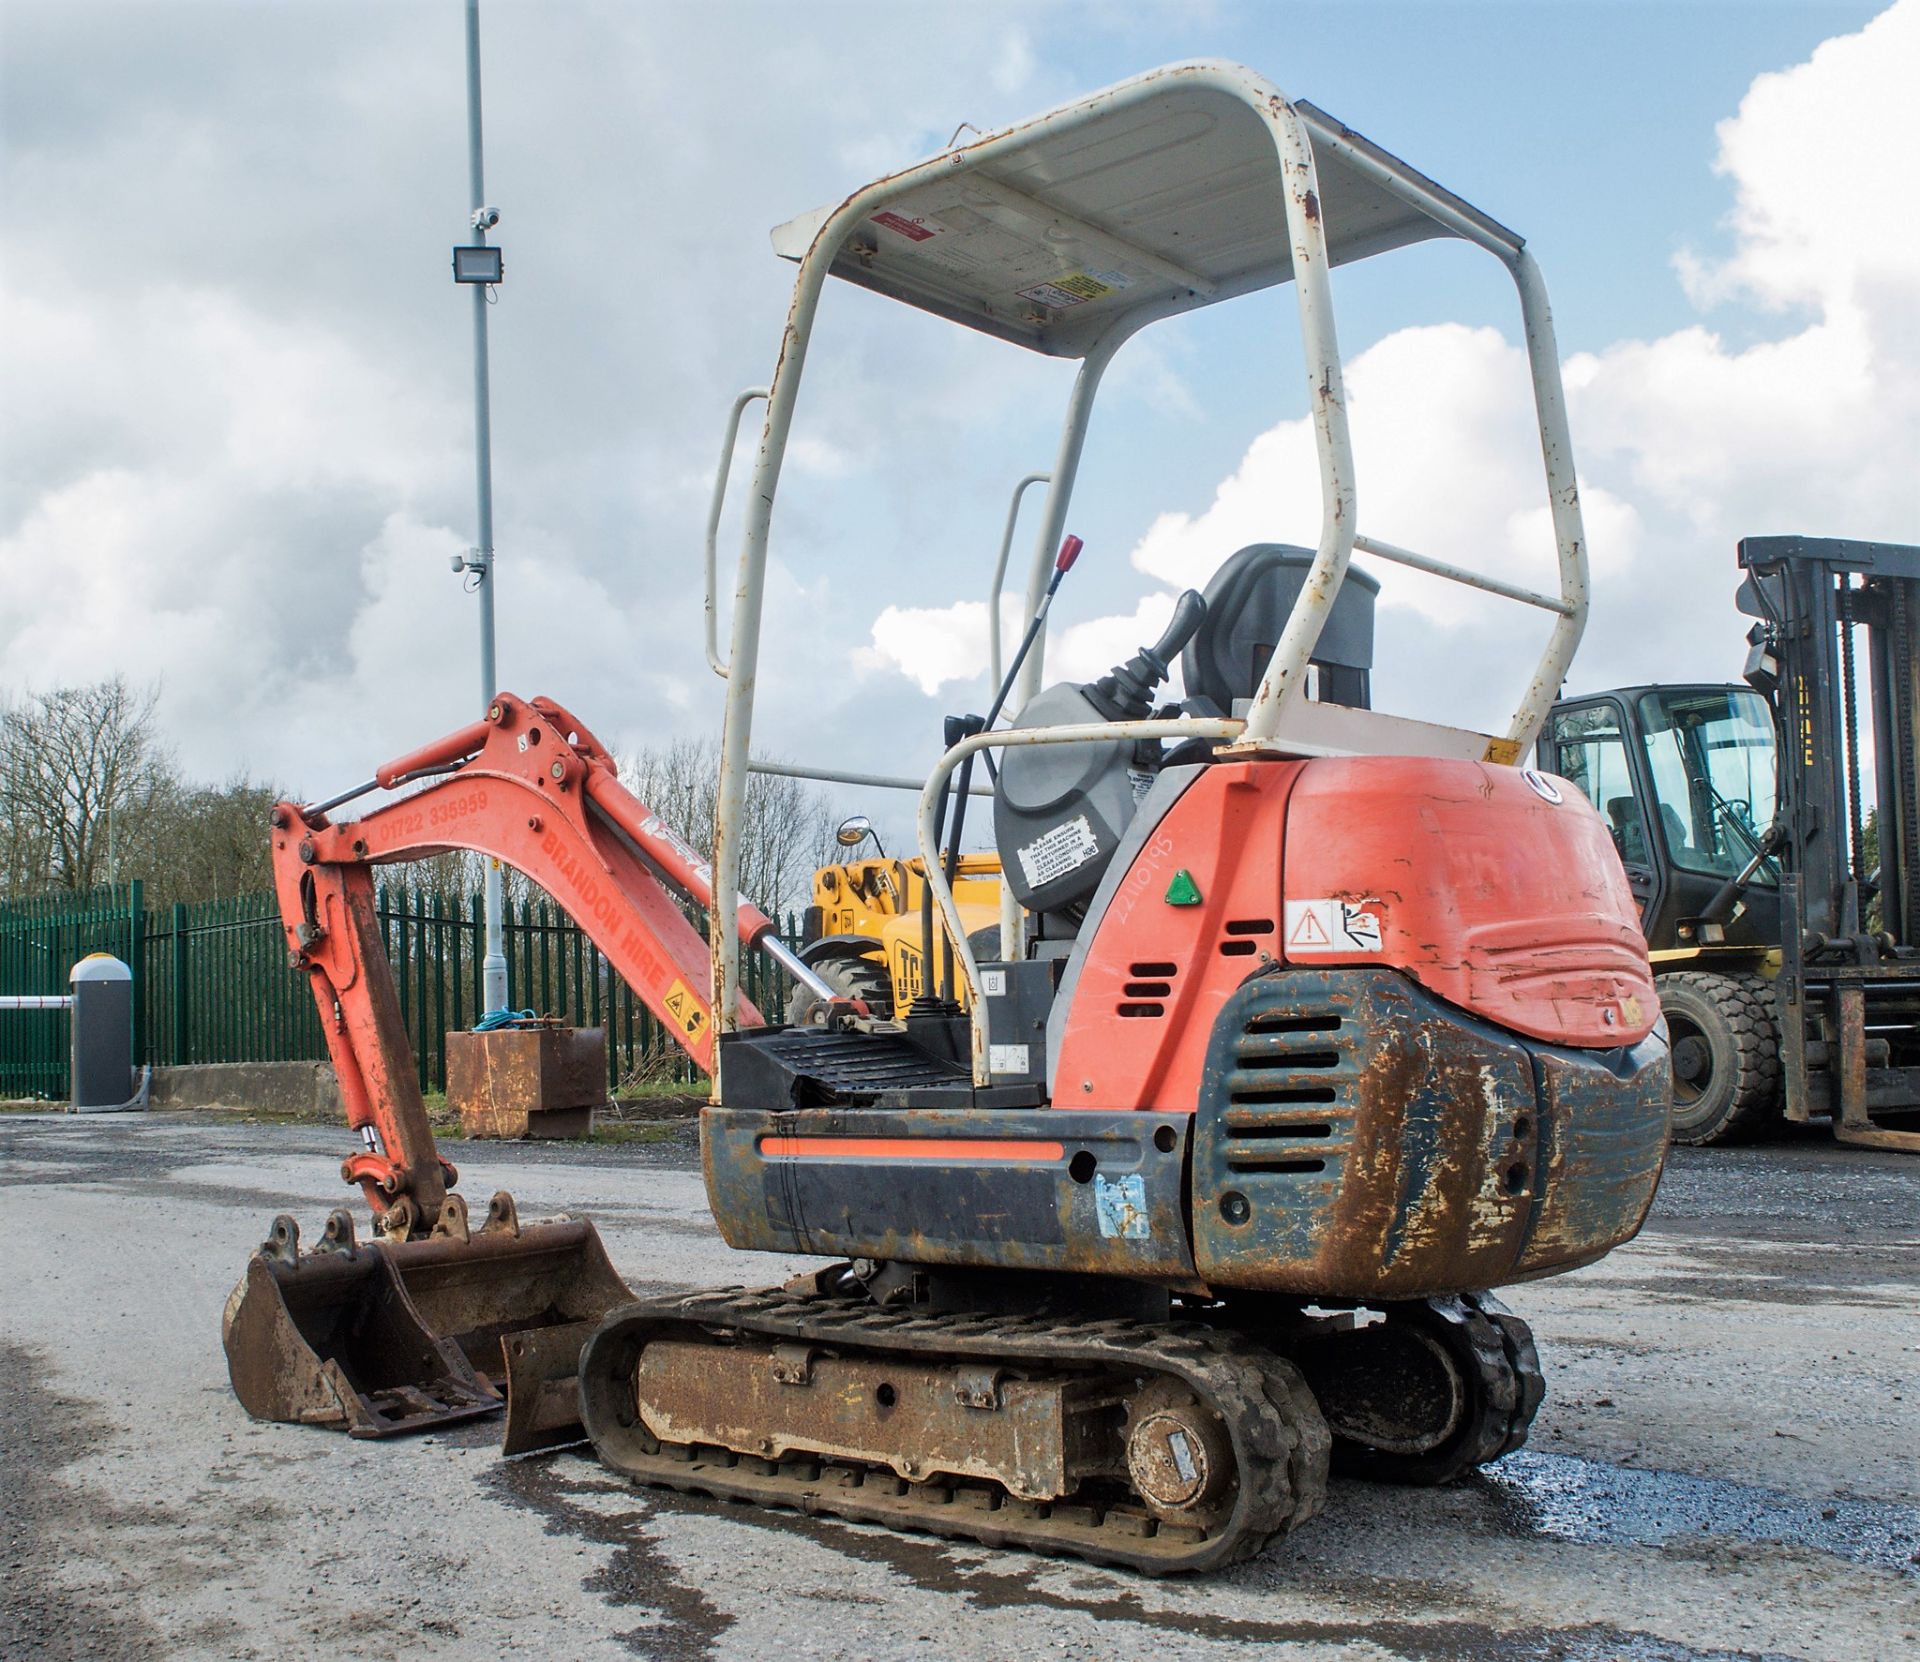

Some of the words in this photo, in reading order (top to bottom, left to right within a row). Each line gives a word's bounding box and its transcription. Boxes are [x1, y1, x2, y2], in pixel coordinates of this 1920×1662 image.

[1030, 850, 1043, 860] THAT
[1045, 843, 1057, 852] THIS
[1058, 829, 1082, 845] MACHINE
[1033, 838, 1053, 852] PLEASE
[1053, 826, 1075, 840] ENSURE
[1041, 842, 1069, 860] RETURNED
[1036, 859, 1054, 870] CLEAN
[1054, 842, 1084, 860] CONDITION
[1046, 856, 1072, 872] CLEANING
[541, 831, 622, 937] BRANDON
[621, 929, 666, 990] HIRE
[898, 947, 924, 1000] JC
